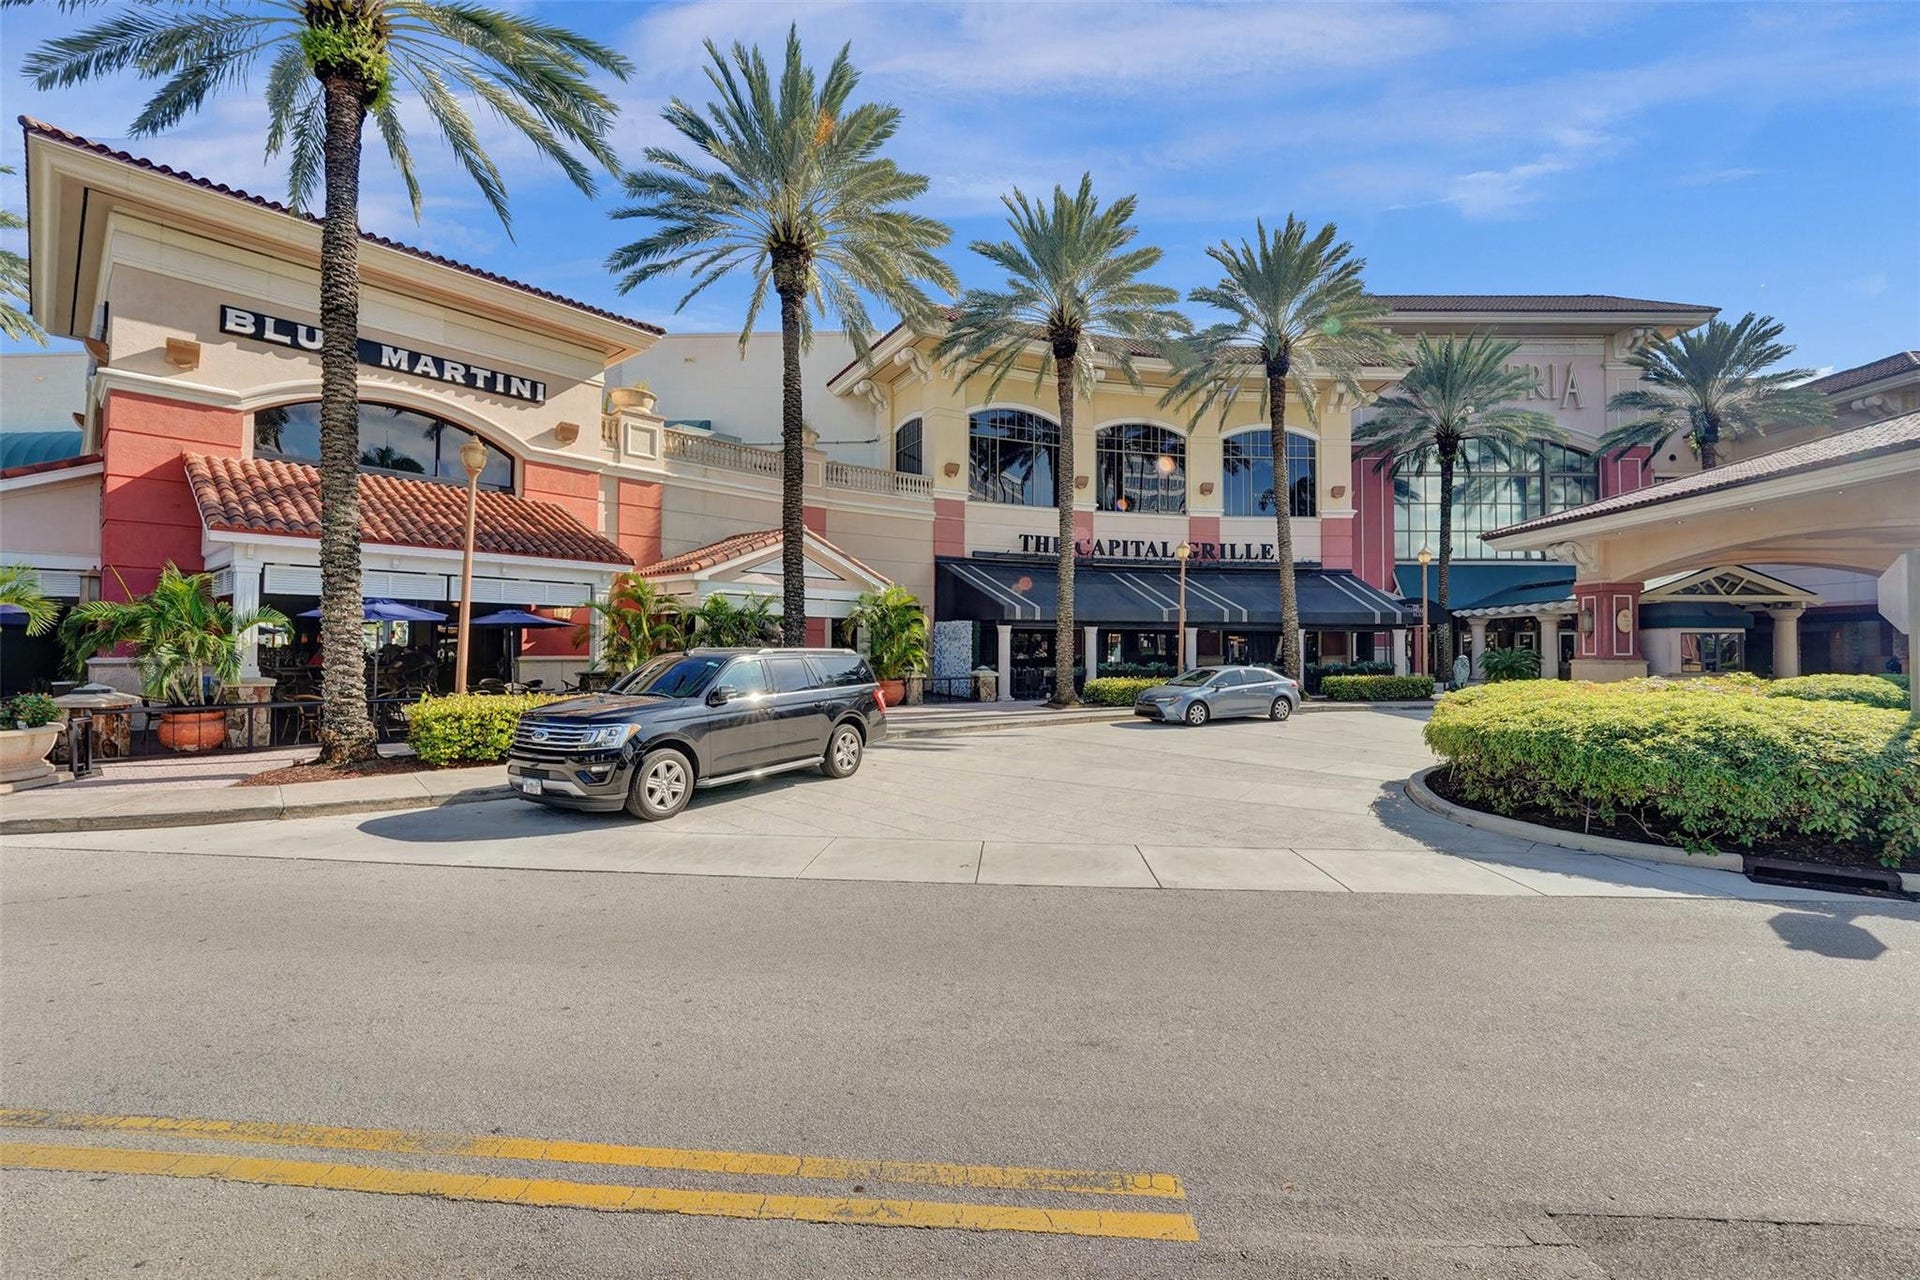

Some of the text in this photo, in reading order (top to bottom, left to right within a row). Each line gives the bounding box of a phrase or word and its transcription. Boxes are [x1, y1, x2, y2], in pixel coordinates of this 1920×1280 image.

[224, 307, 545, 401] BLU MARTINI
[1075, 538, 1175, 559] CAPITAL
[1187, 541, 1274, 560] GRILLE
